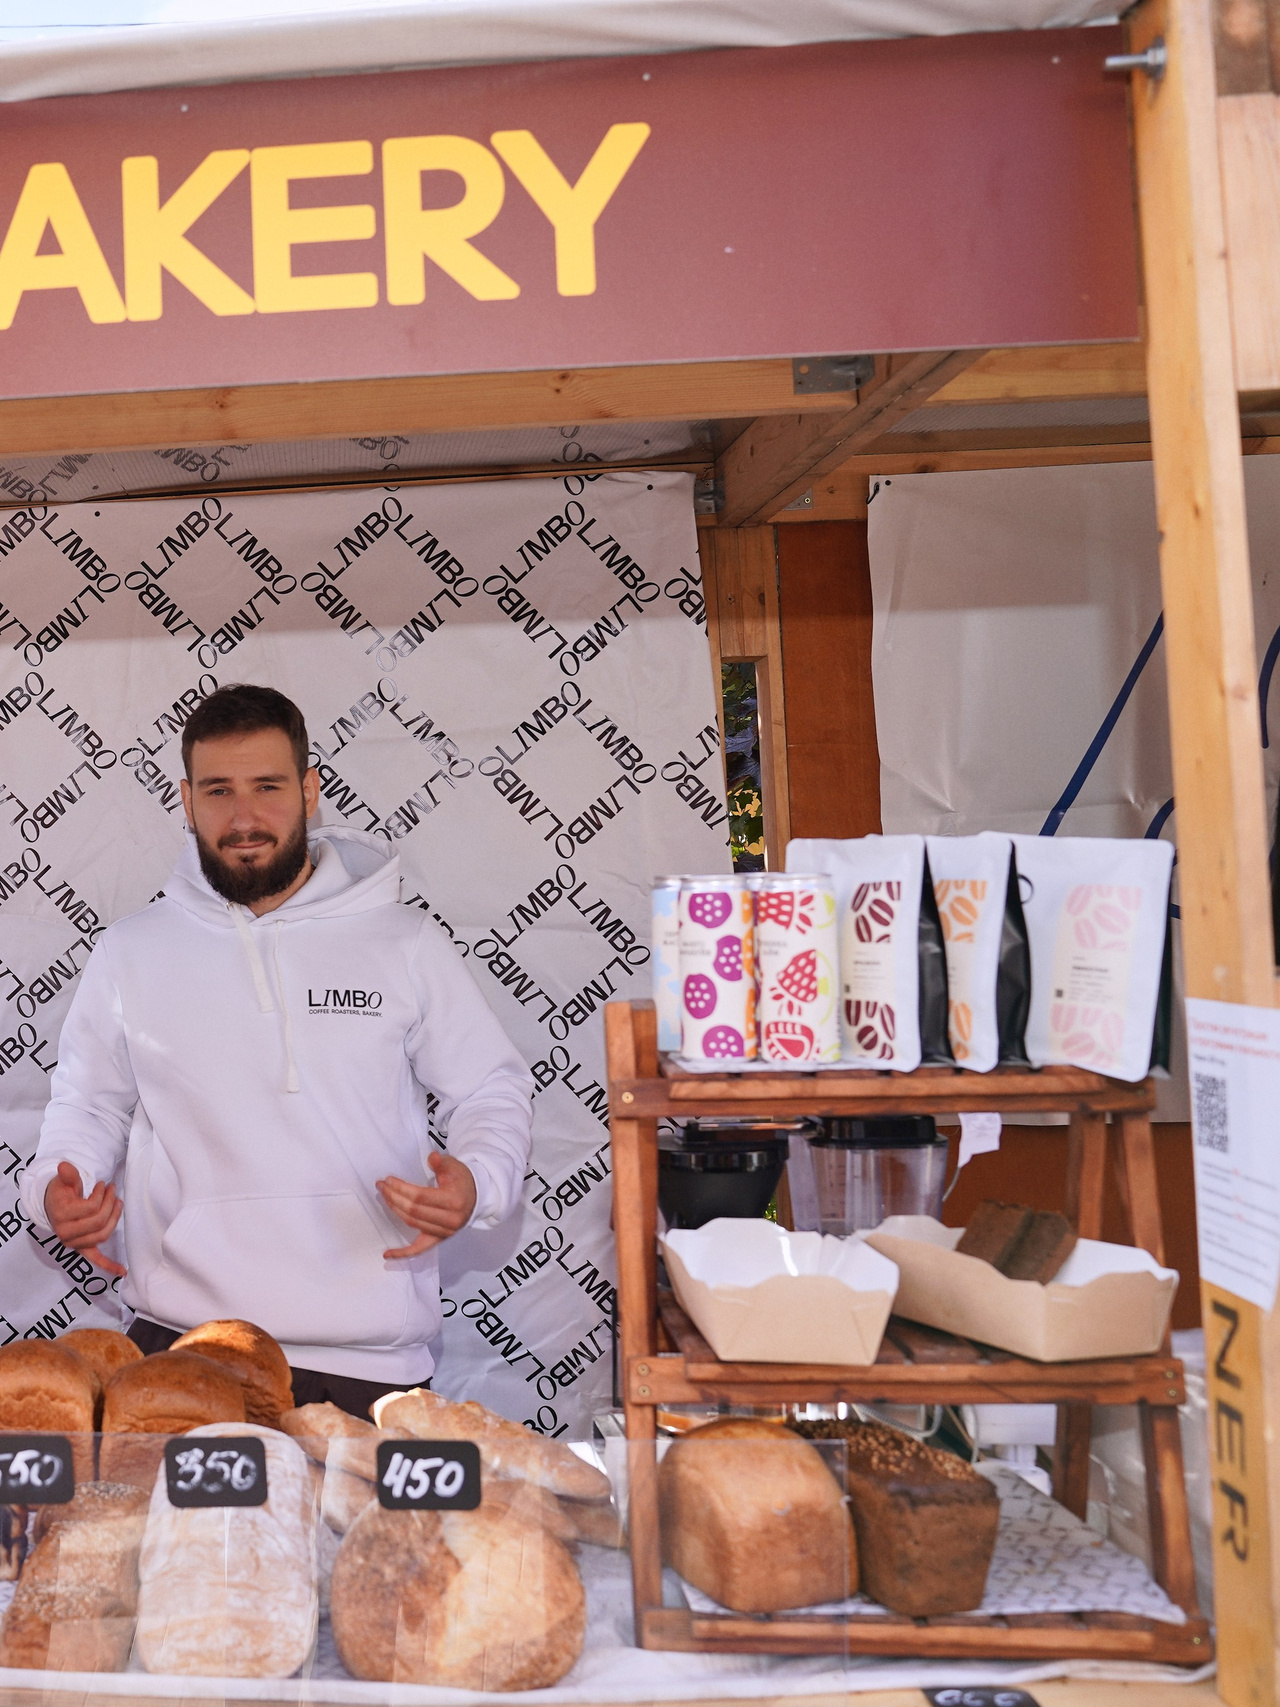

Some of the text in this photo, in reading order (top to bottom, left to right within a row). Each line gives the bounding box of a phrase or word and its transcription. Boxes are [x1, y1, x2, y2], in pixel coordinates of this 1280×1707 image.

[39, 512, 121, 593] LIMBO
[140, 497, 222, 580] LIMBO
[214, 512, 297, 594] LIMBO
[317, 497, 402, 581] LIMBO
[393, 514, 479, 597] LIMBO
[499, 501, 585, 584] LIMBO
[576, 518, 660, 603] LIMBO
[24, 584, 105, 667] LIMBO
[124, 571, 206, 652] LIMBO
[198, 586, 281, 669] LIMBO
[301, 572, 385, 655] LIMBO
[376, 588, 462, 672] LIMBO
[483, 575, 568, 659] LIMBO
[560, 593, 644, 676] LIMBO
[36, 688, 117, 769] LIMBO
[312, 679, 395, 758] LIMBO
[389, 694, 475, 779] LIMBO
[495, 681, 581, 765] LIMBO
[572, 698, 657, 784] LIMBO
[21, 761, 101, 843] LIMBO
[120, 748, 183, 813] IMBO
[478, 756, 564, 841] LIMBO
[555, 774, 641, 859] LIMBO
[660, 761, 729, 830] IMBO
[490, 864, 576, 948] LIMBO
[567, 881, 652, 965] LIMBO
[17, 937, 93, 1018] LIMBO
[308, 989, 383, 1010] LIMBO
[473, 939, 558, 1023] LIMBO
[549, 956, 634, 1040] LIMBO
[559, 1062, 611, 1131] LIM
[478, 1226, 563, 1309] LIMBO
[556, 1243, 618, 1315] LIMB
[23, 1287, 91, 1341] LIMB
[461, 1299, 546, 1382] LIMBO
[536, 1318, 620, 1400] LIMBO
[381, 1451, 466, 1501] 450
